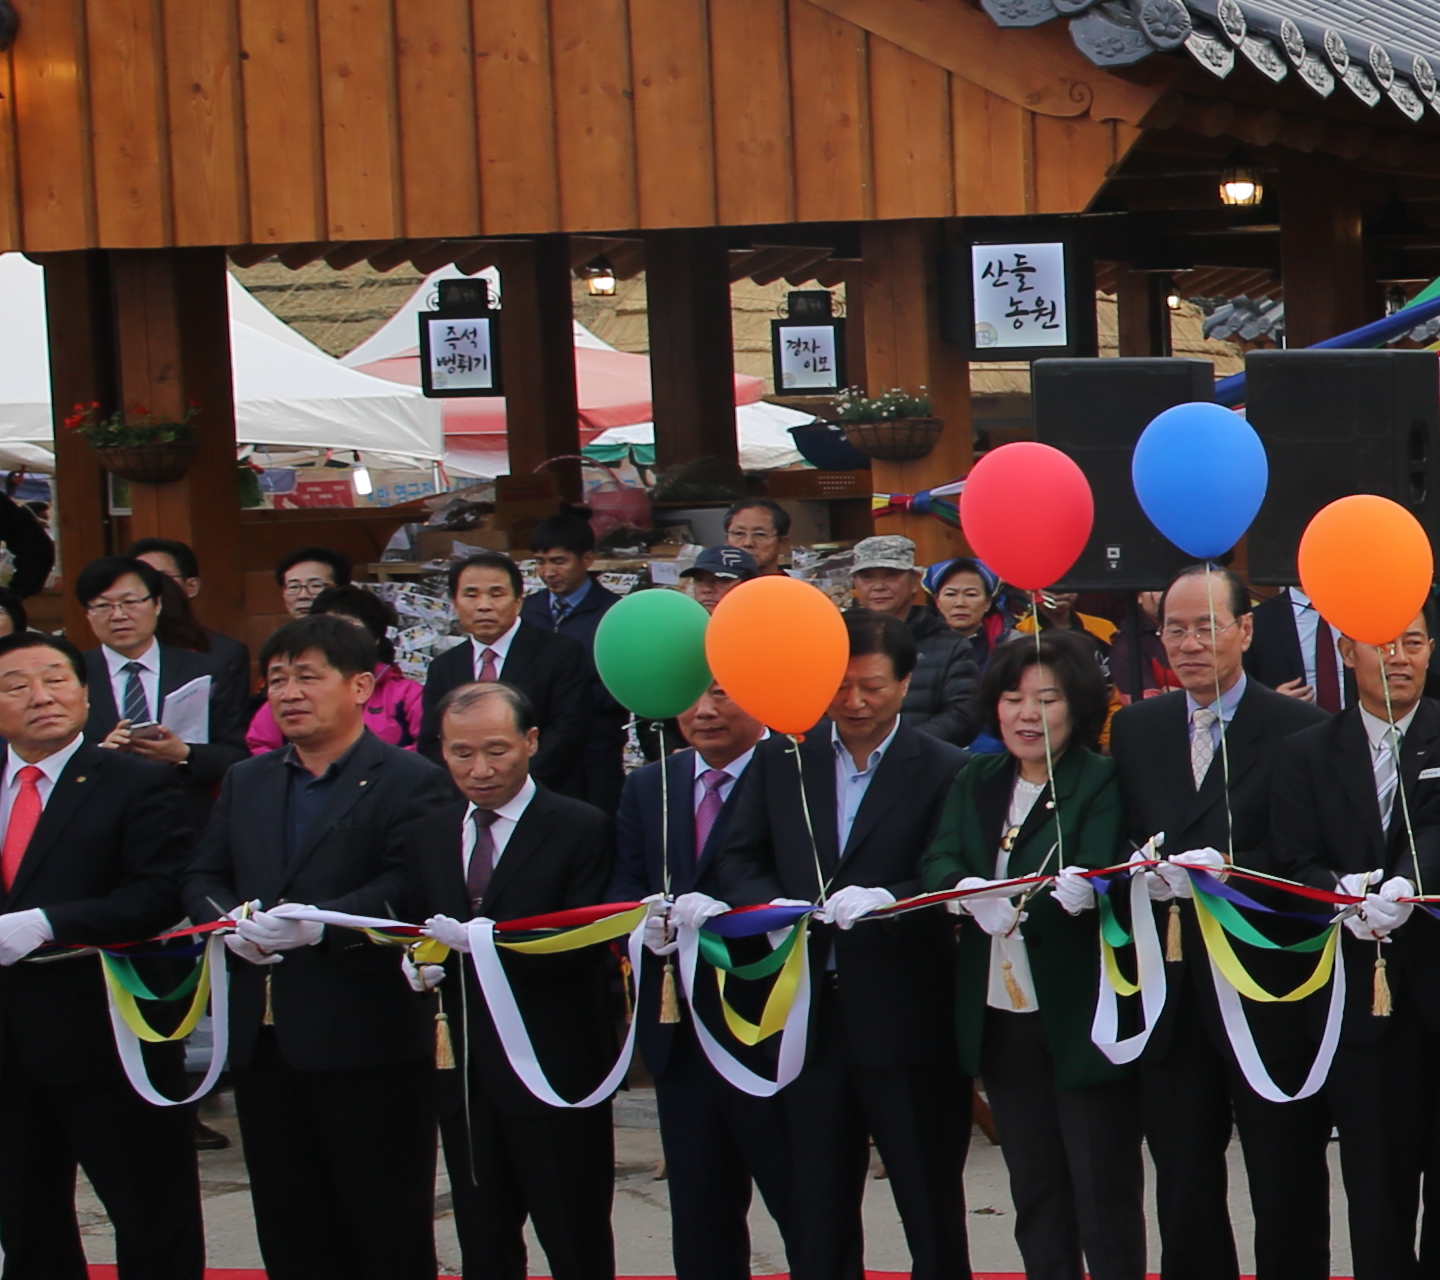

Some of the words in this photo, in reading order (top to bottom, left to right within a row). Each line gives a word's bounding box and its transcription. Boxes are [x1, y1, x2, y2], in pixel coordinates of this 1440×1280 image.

[981, 253, 1036, 293] 산들
[1005, 296, 1060, 329] 농원
[446, 325, 478, 348] 즉석
[785, 337, 821, 357] 경자
[436, 355, 488, 374] 뻥튀기
[803, 356, 832, 373] 이모
